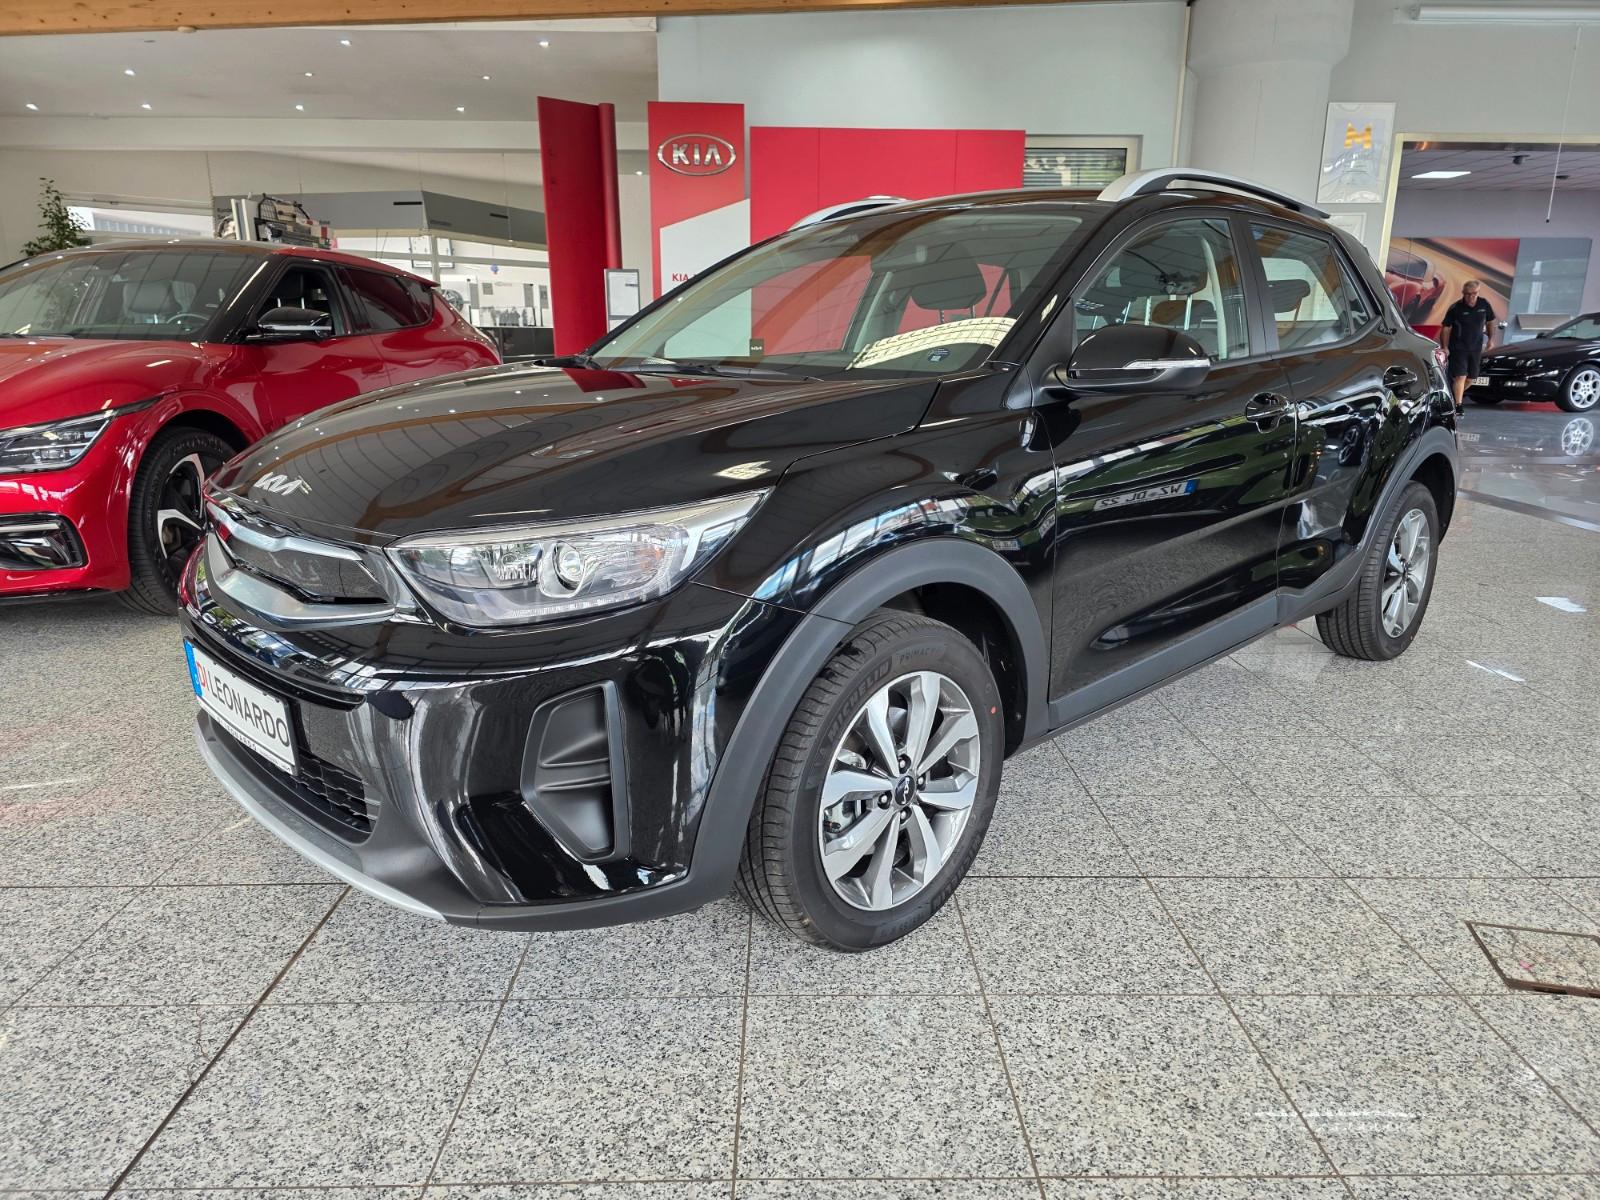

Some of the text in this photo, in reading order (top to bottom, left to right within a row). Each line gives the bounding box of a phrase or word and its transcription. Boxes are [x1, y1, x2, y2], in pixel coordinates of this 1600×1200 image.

[672, 143, 722, 166] KIA
[208, 670, 290, 748] LEONARDO
[826, 660, 889, 740] MICHELIN
